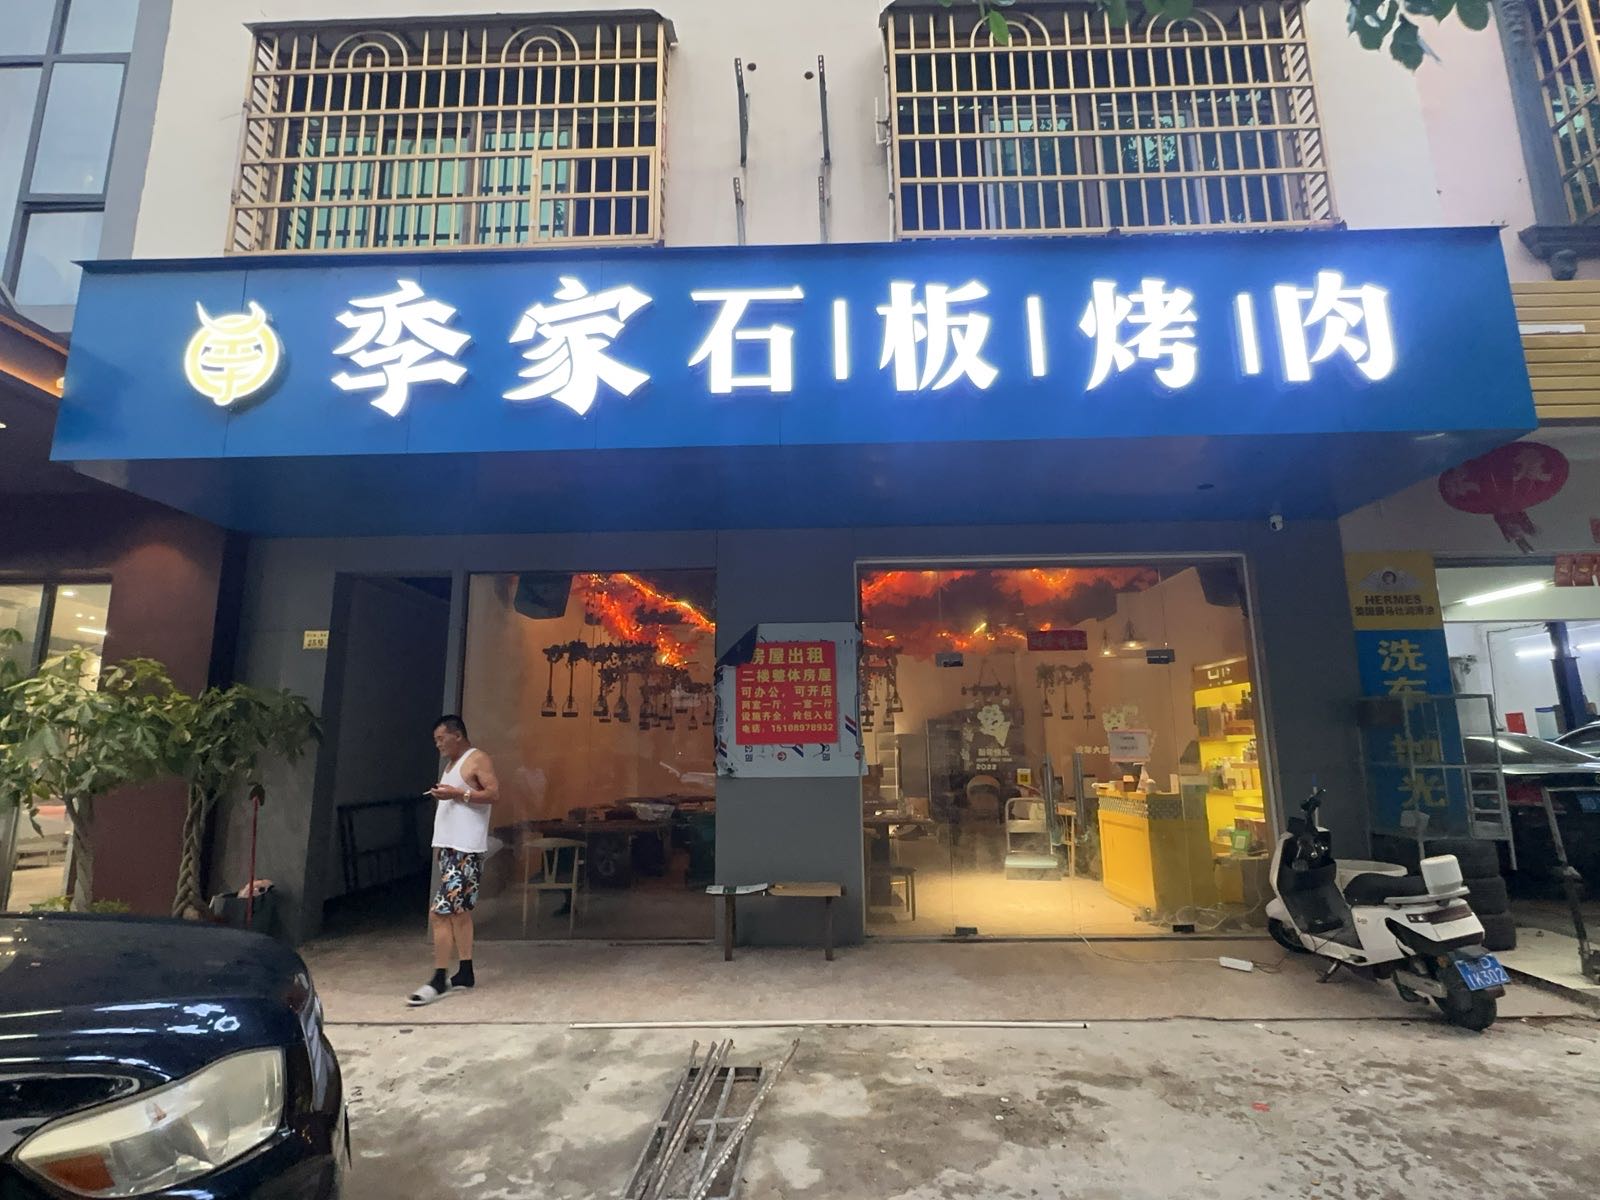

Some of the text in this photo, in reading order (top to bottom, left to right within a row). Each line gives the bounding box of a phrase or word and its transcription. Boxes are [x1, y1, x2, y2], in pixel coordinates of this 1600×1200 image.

[1365, 594, 1421, 605] HERMES
[751, 647, 824, 665] 房屋出租
[742, 668, 832, 683] 二楼整体房屋
